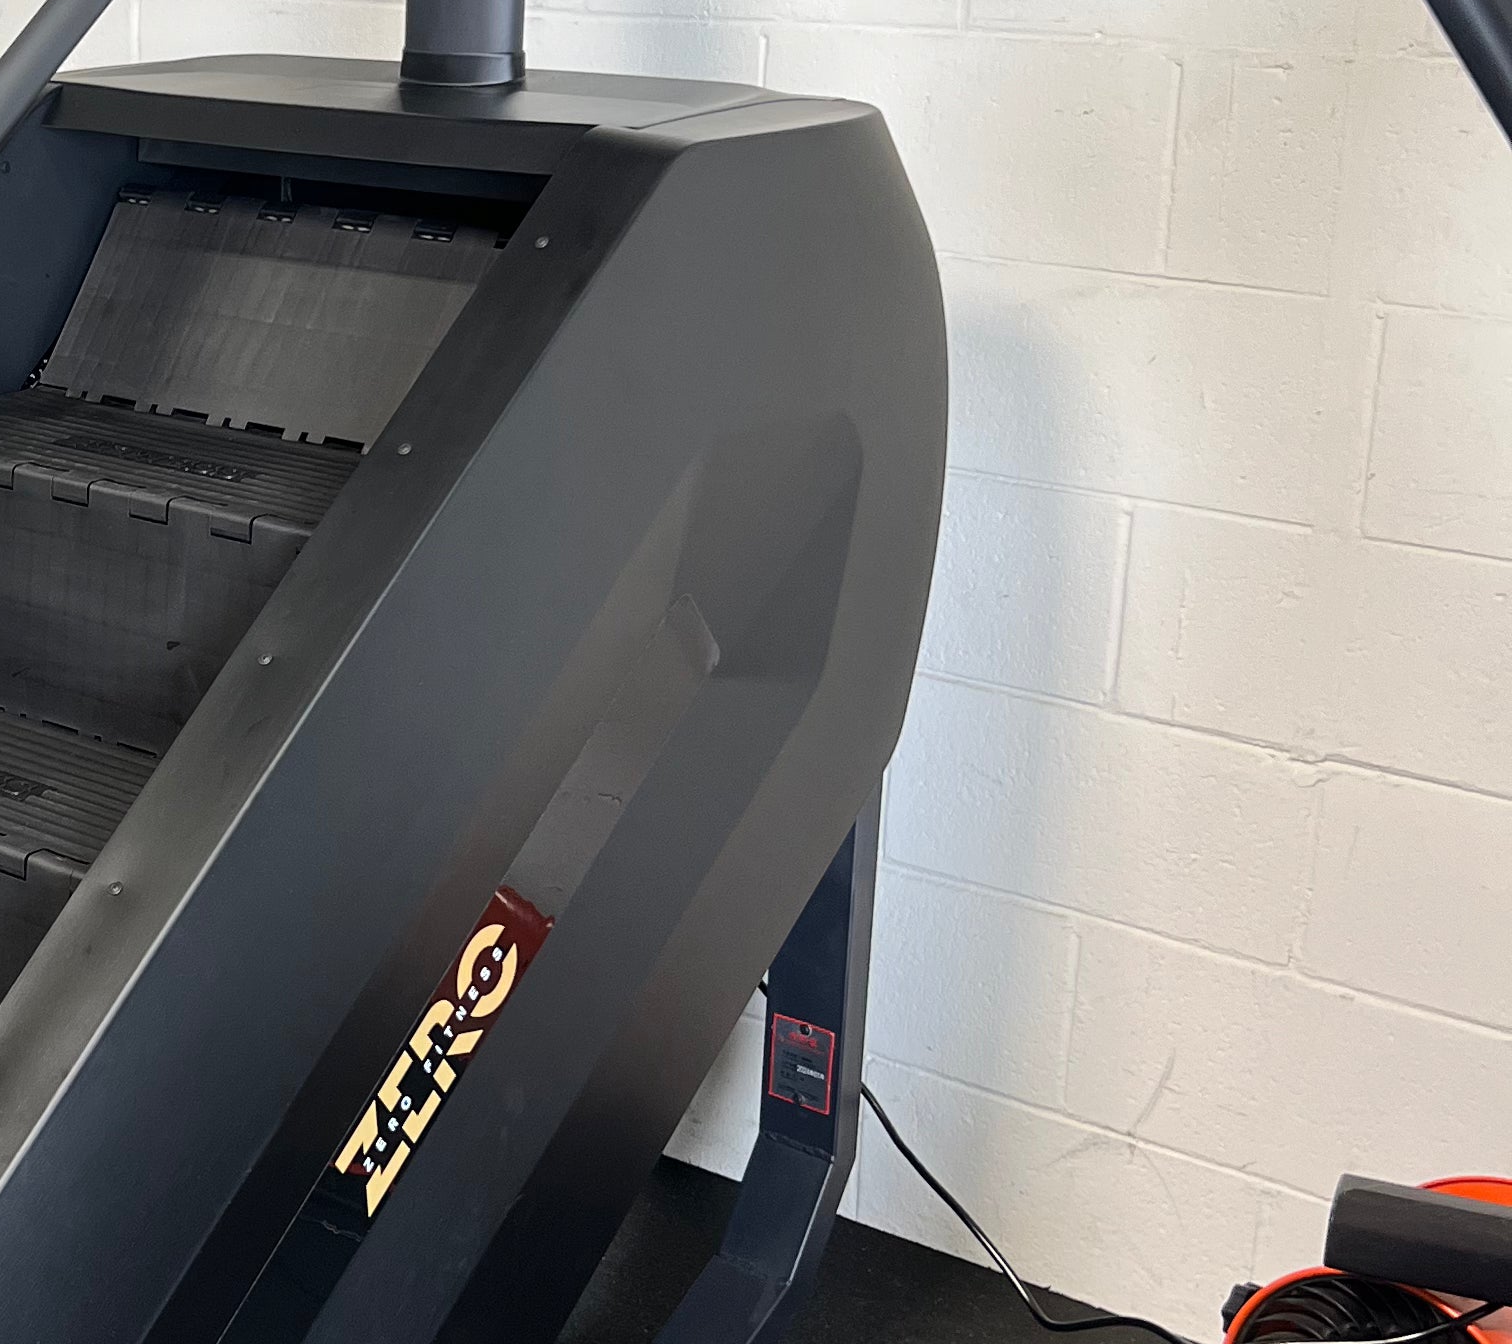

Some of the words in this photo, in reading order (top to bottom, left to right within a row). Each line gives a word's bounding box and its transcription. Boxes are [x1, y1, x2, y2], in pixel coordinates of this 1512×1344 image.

[334, 923, 518, 1218] ZERO
[362, 1094, 412, 1173] ZERO
[421, 946, 504, 1074] FITNESS
